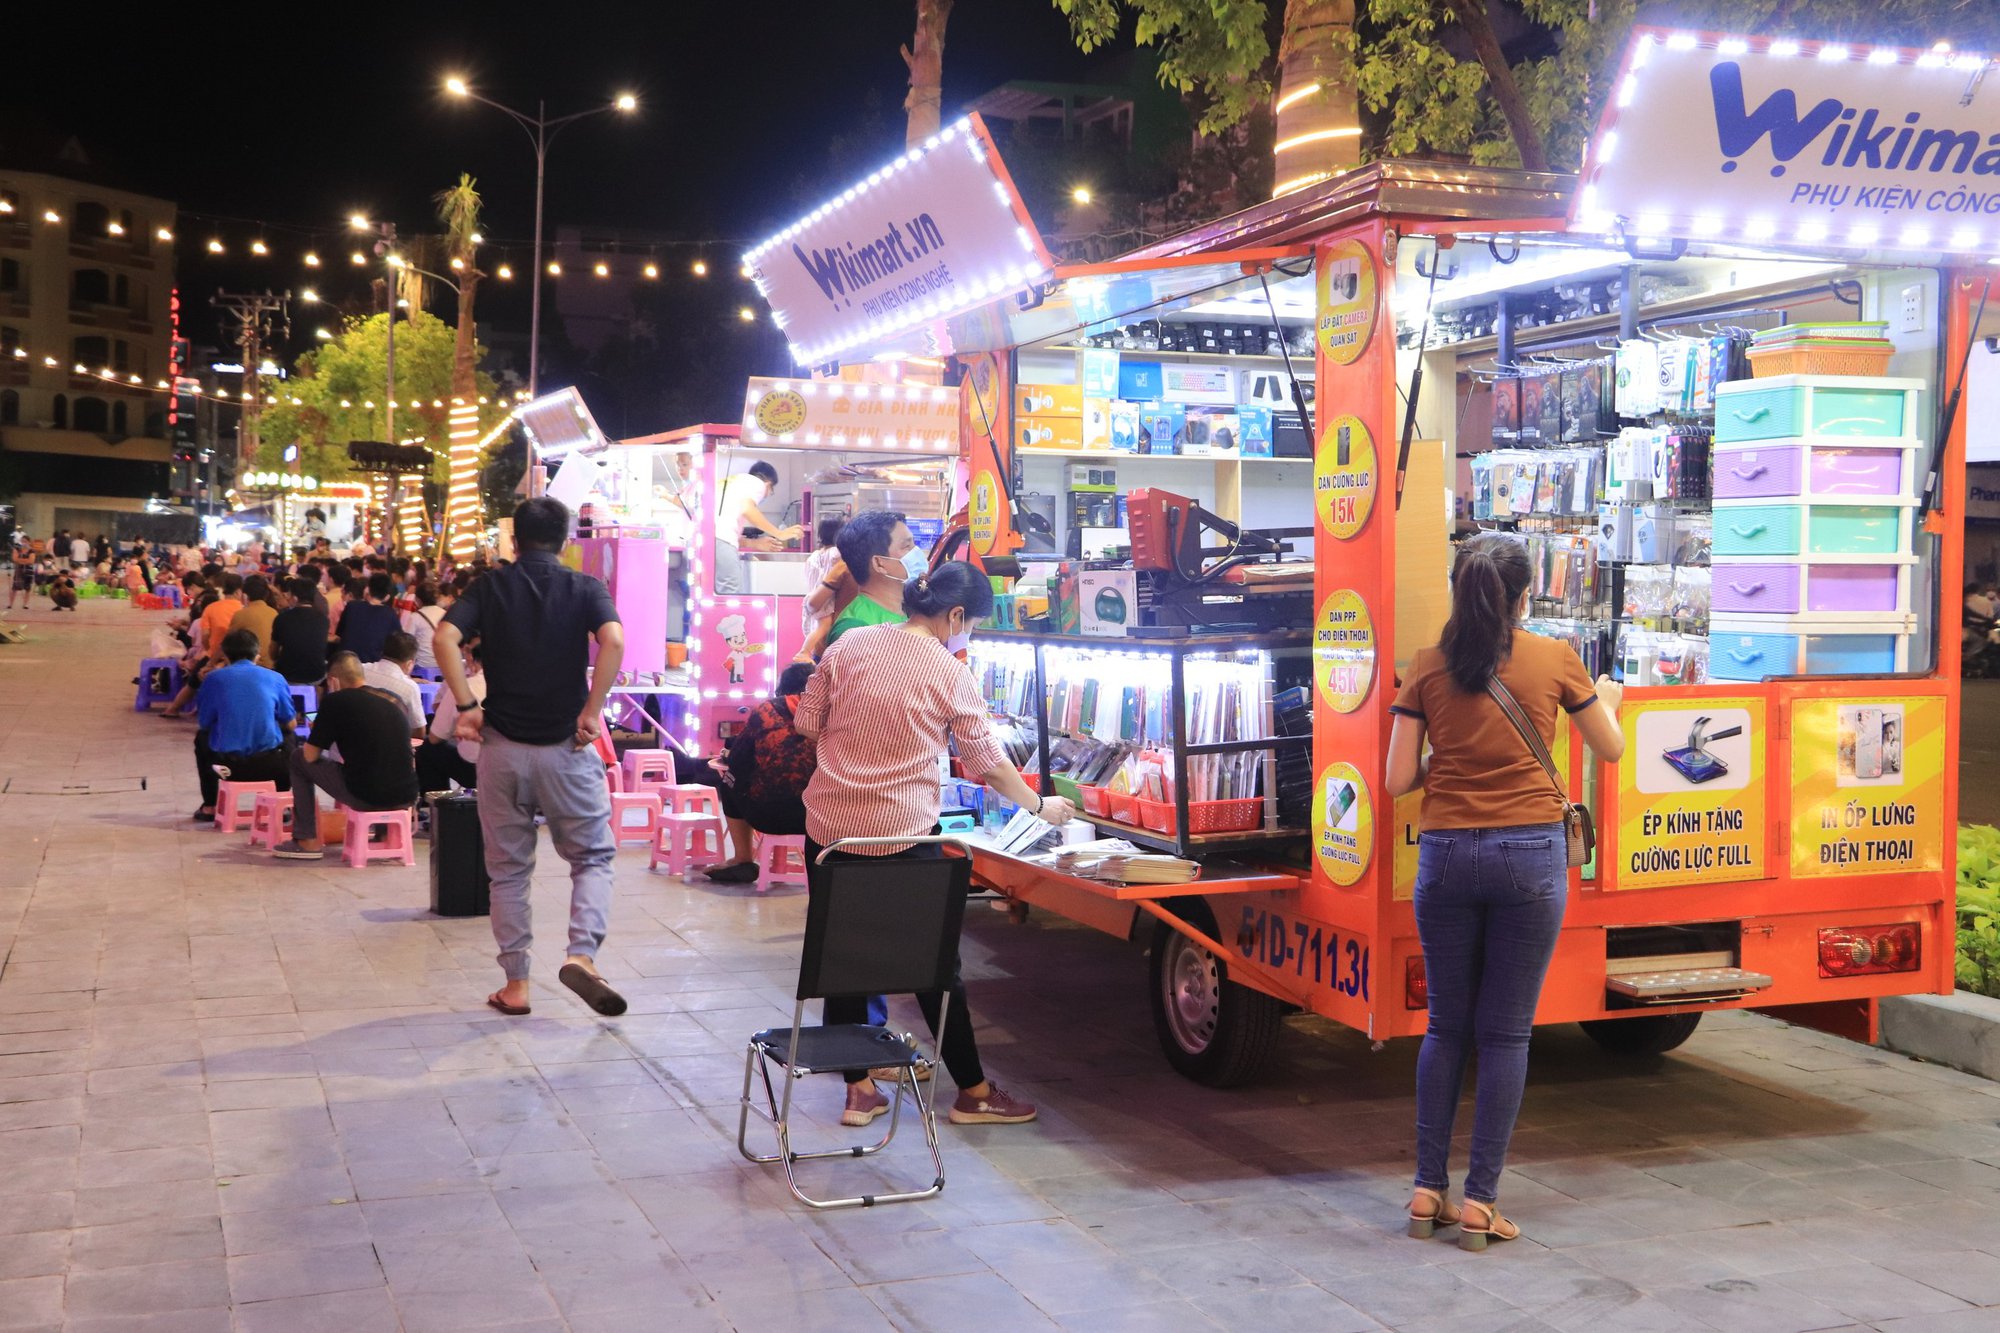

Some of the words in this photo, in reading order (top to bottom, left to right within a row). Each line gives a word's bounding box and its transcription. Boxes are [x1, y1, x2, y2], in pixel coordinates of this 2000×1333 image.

[1790, 182, 1850, 212] PHỤ
[1854, 184, 1921, 214] KIỆN
[1926, 184, 2000, 214] CÔNG
[792, 213, 945, 312] Wikimart.vn
[1344, 310, 1368, 326] CAMERA
[1331, 334, 1345, 347] QUAN
[858, 401, 883, 415] GIA
[1330, 496, 1356, 524] 15K
[1344, 611, 1356, 623] PPF
[1318, 630, 1331, 641] CHO
[1333, 628, 1348, 642] ĐIỆN
[1350, 630, 1369, 643] THOẠI
[1328, 667, 1358, 694] 45K
[1643, 807, 1662, 836] ÉP
[1667, 808, 1701, 834] KÍNH
[1706, 808, 1743, 837] TẶNG
[1821, 808, 1838, 829] IN
[1844, 799, 1866, 829] ỐP
[1872, 801, 1915, 826] LƯNG
[1348, 852, 1361, 866] FULL
[1631, 844, 1680, 874] CƯỜNG
[1685, 844, 1713, 874] LỰC
[1717, 844, 1752, 867] FULL
[1820, 839, 1859, 868] ĐIỆN
[1865, 839, 1913, 868] THOẠI
